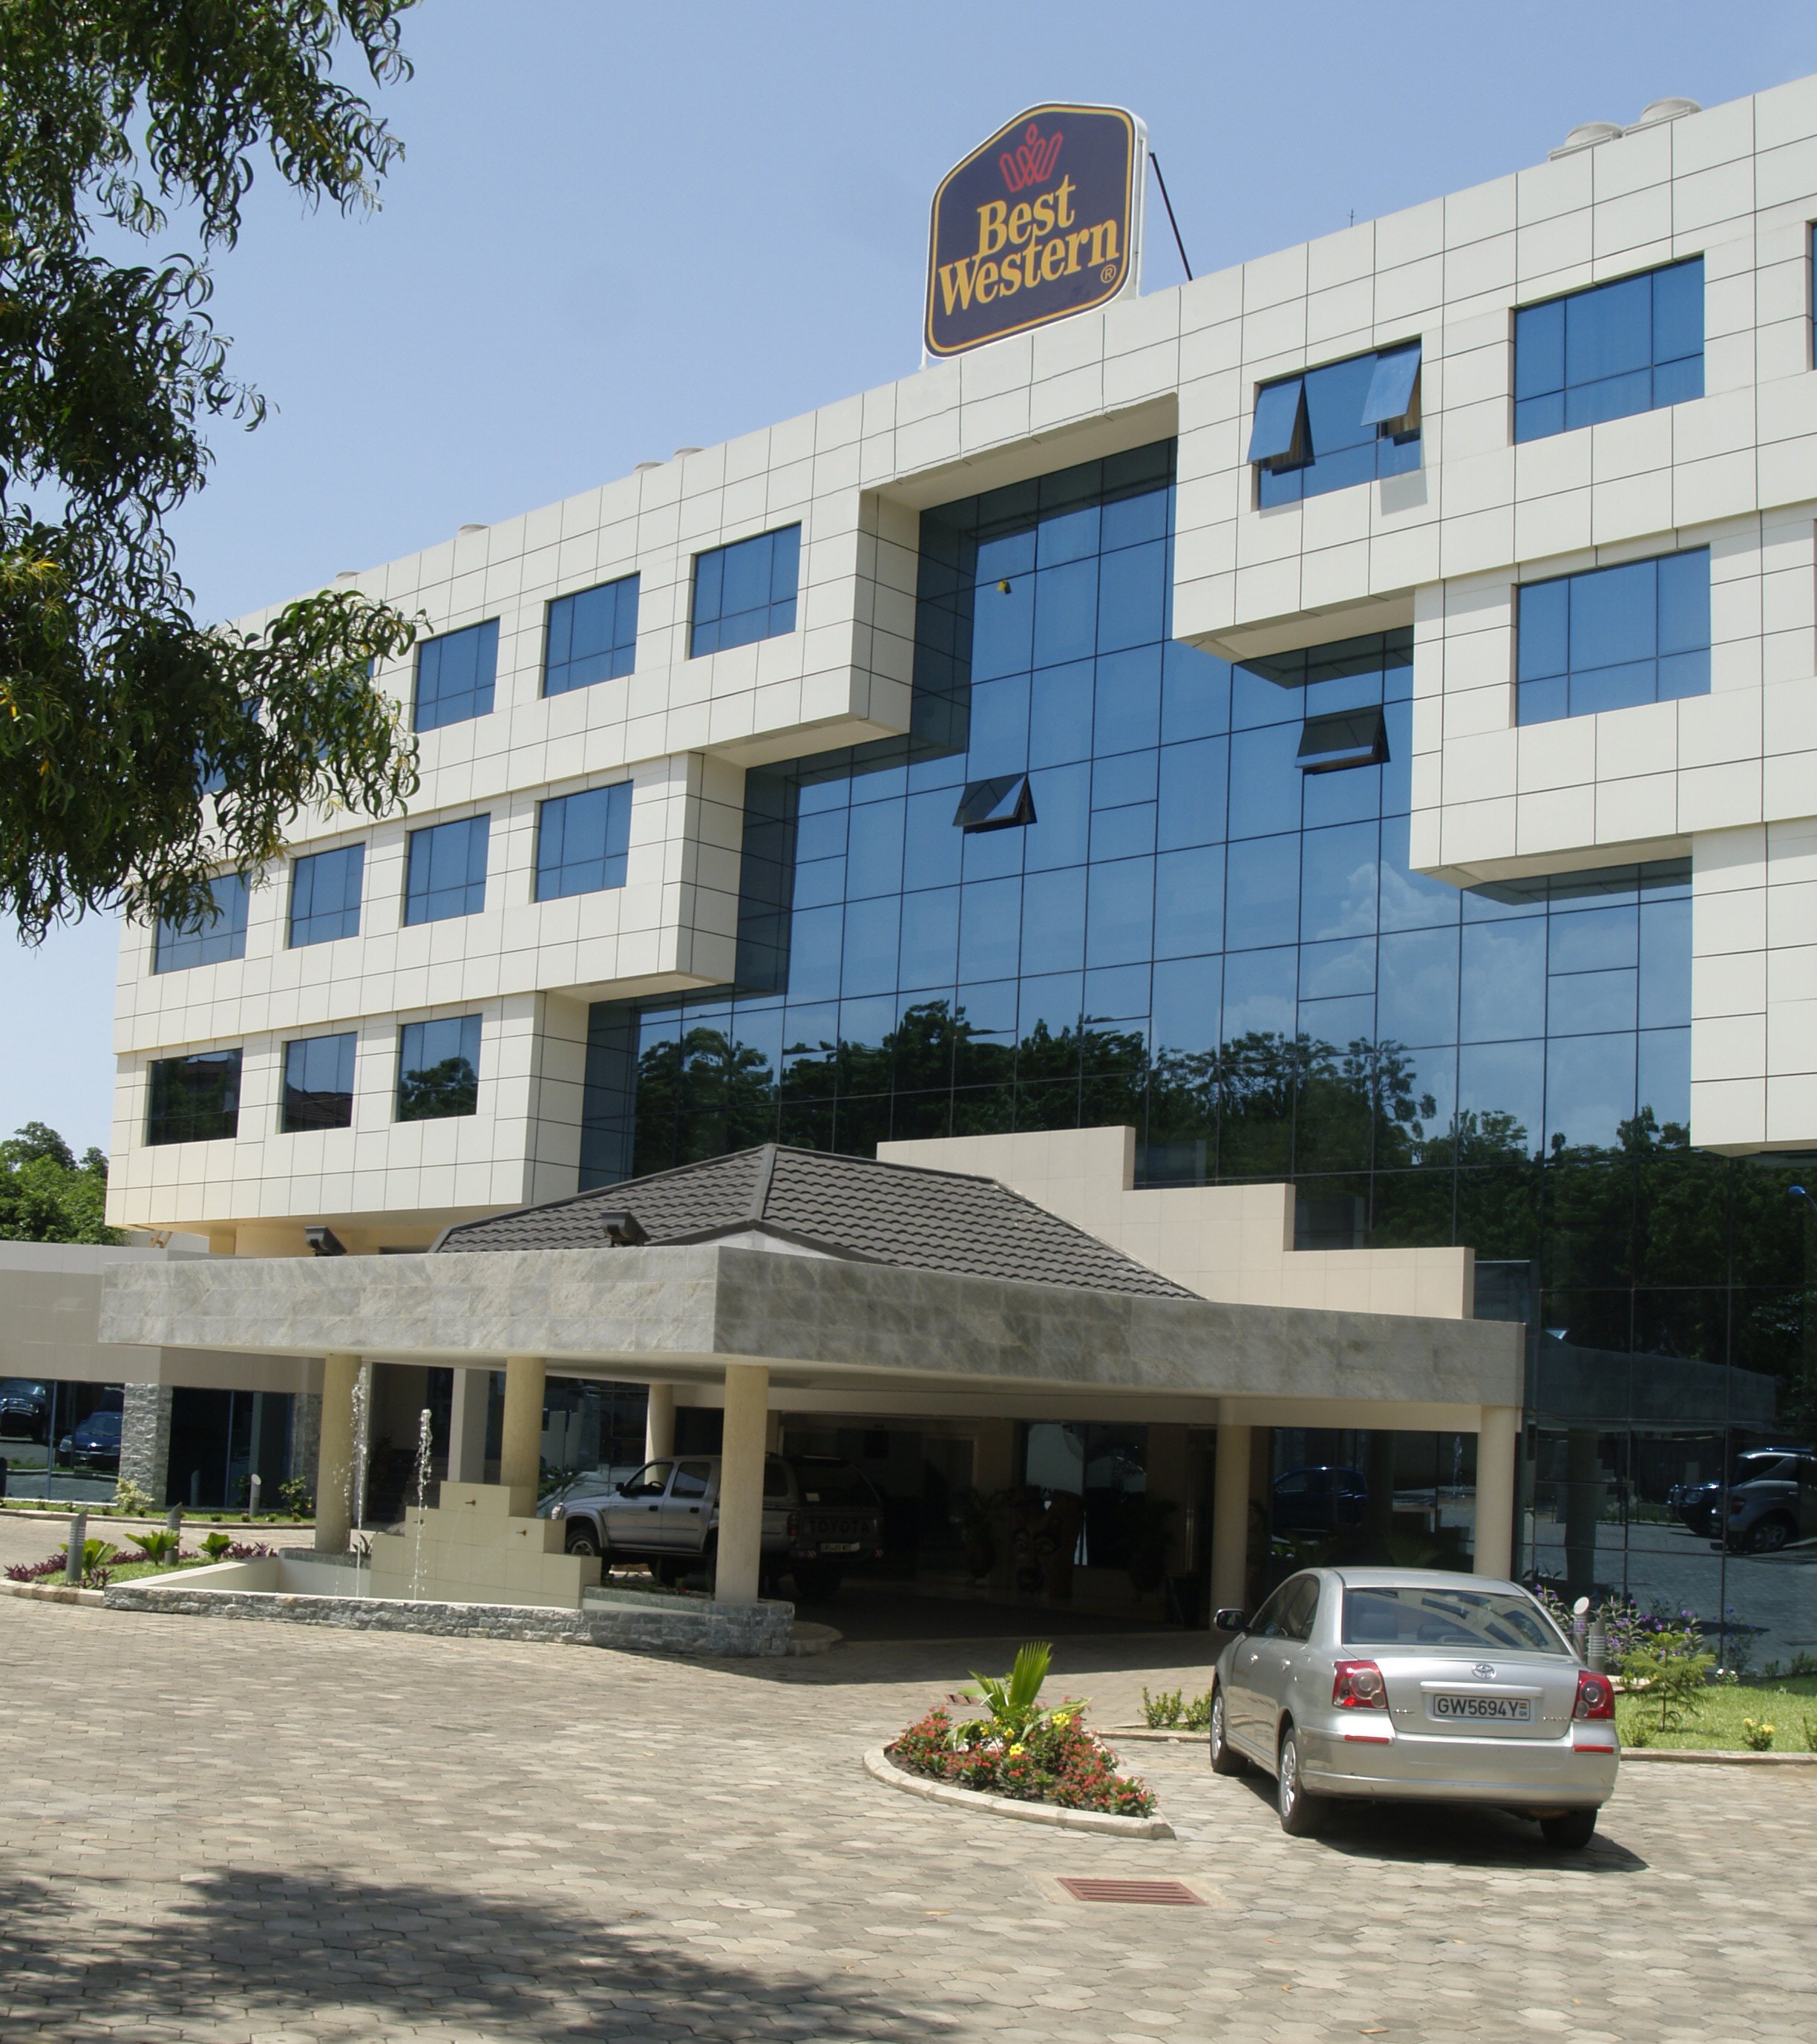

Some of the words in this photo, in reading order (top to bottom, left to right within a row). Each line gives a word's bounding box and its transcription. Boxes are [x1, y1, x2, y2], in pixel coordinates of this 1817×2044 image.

[977, 174, 1076, 257] Best
[938, 219, 1120, 315] Western
[809, 1519, 868, 1533] TOYOTA
[1437, 1698, 1518, 1717] GW5694Y
